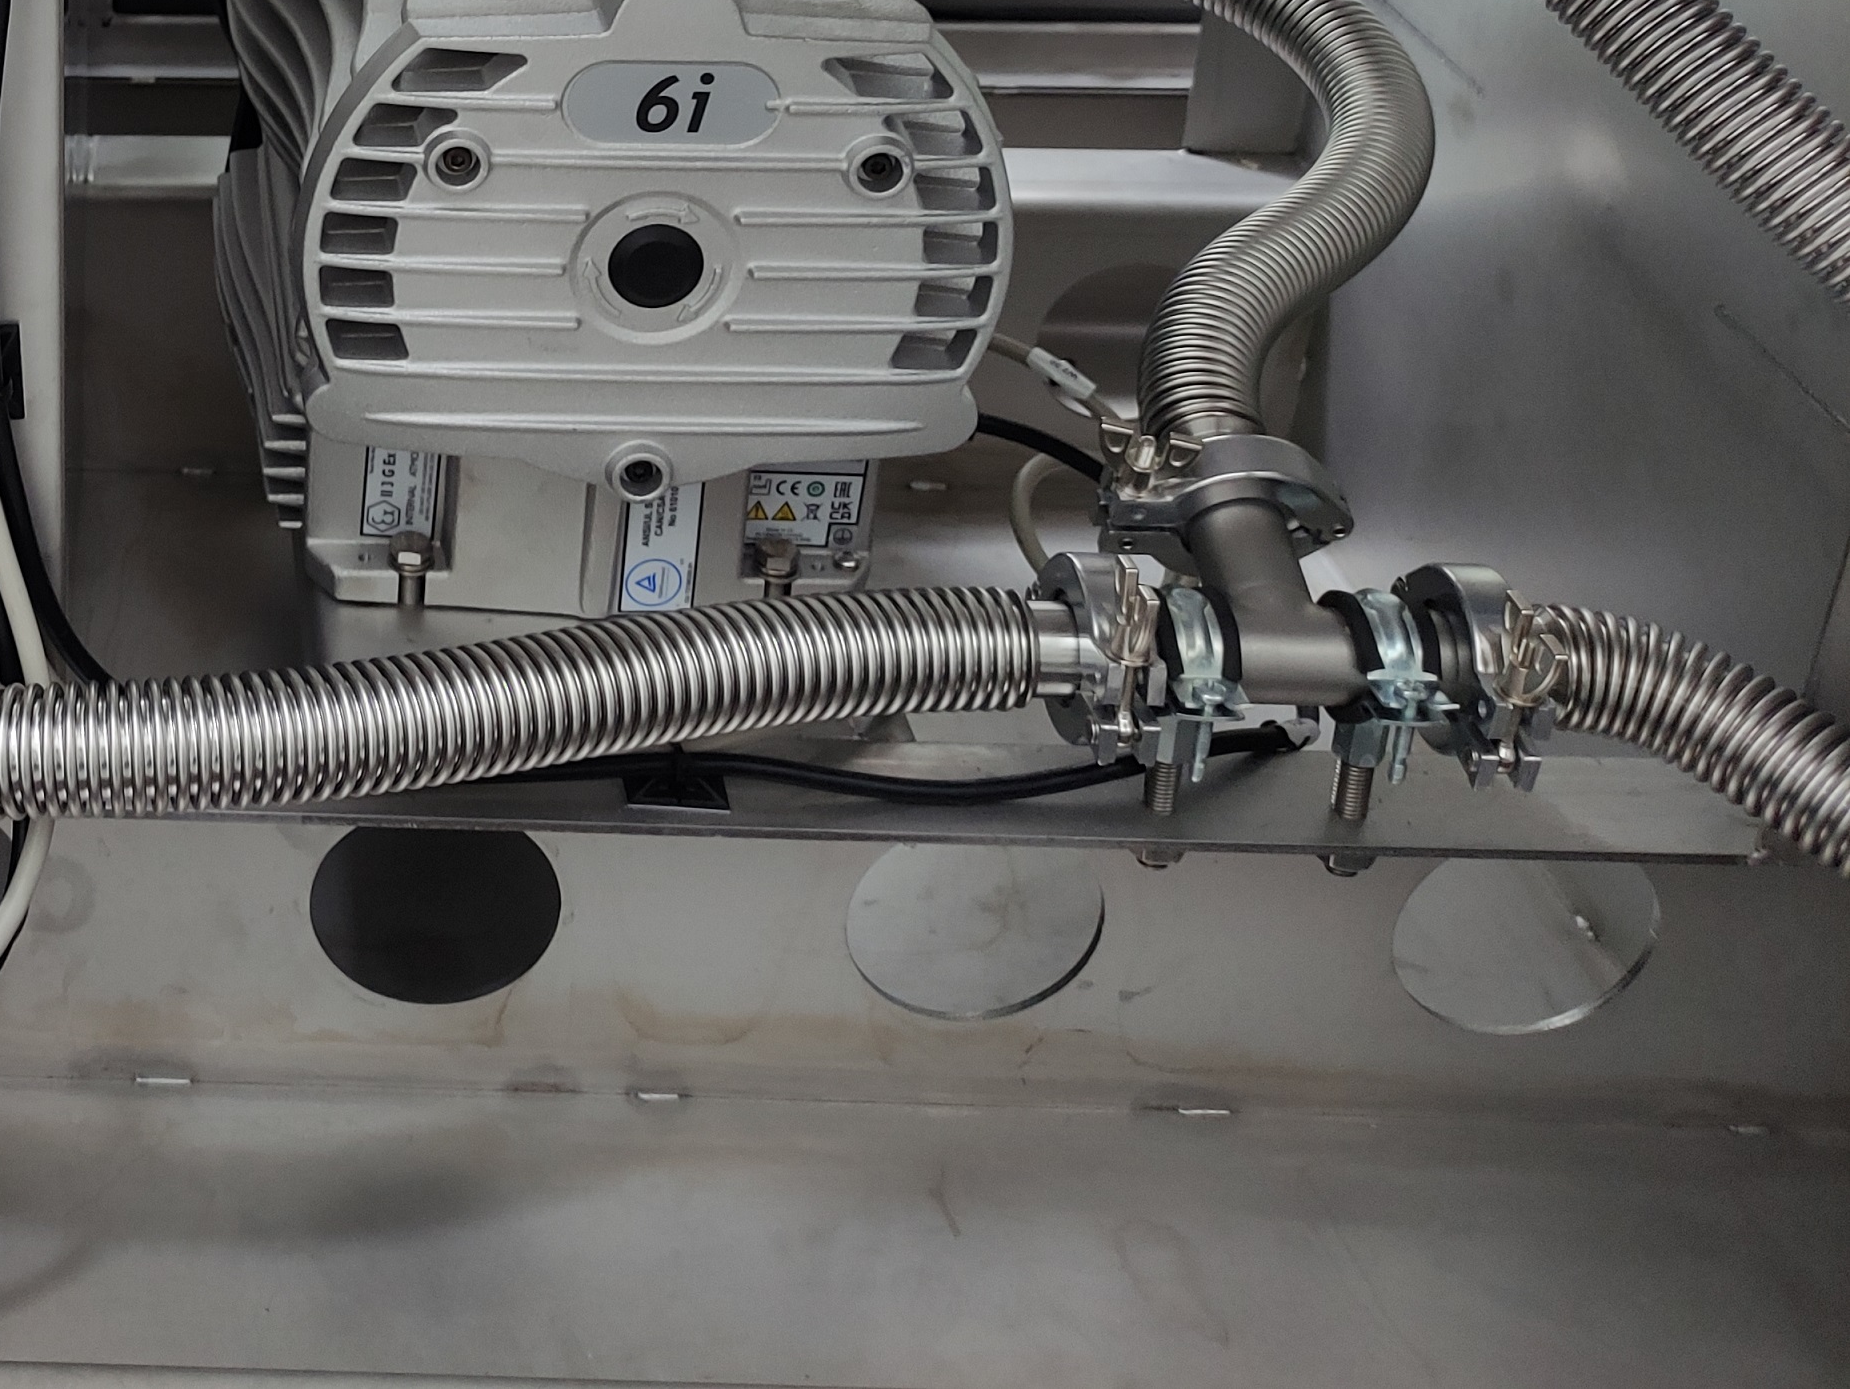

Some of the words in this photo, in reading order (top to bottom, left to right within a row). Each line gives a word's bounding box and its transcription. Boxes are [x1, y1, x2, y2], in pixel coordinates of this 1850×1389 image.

[635, 72, 715, 134] 6i
[383, 452, 396, 466] Ex
[409, 451, 419, 477] ATMO
[382, 468, 395, 478] G
